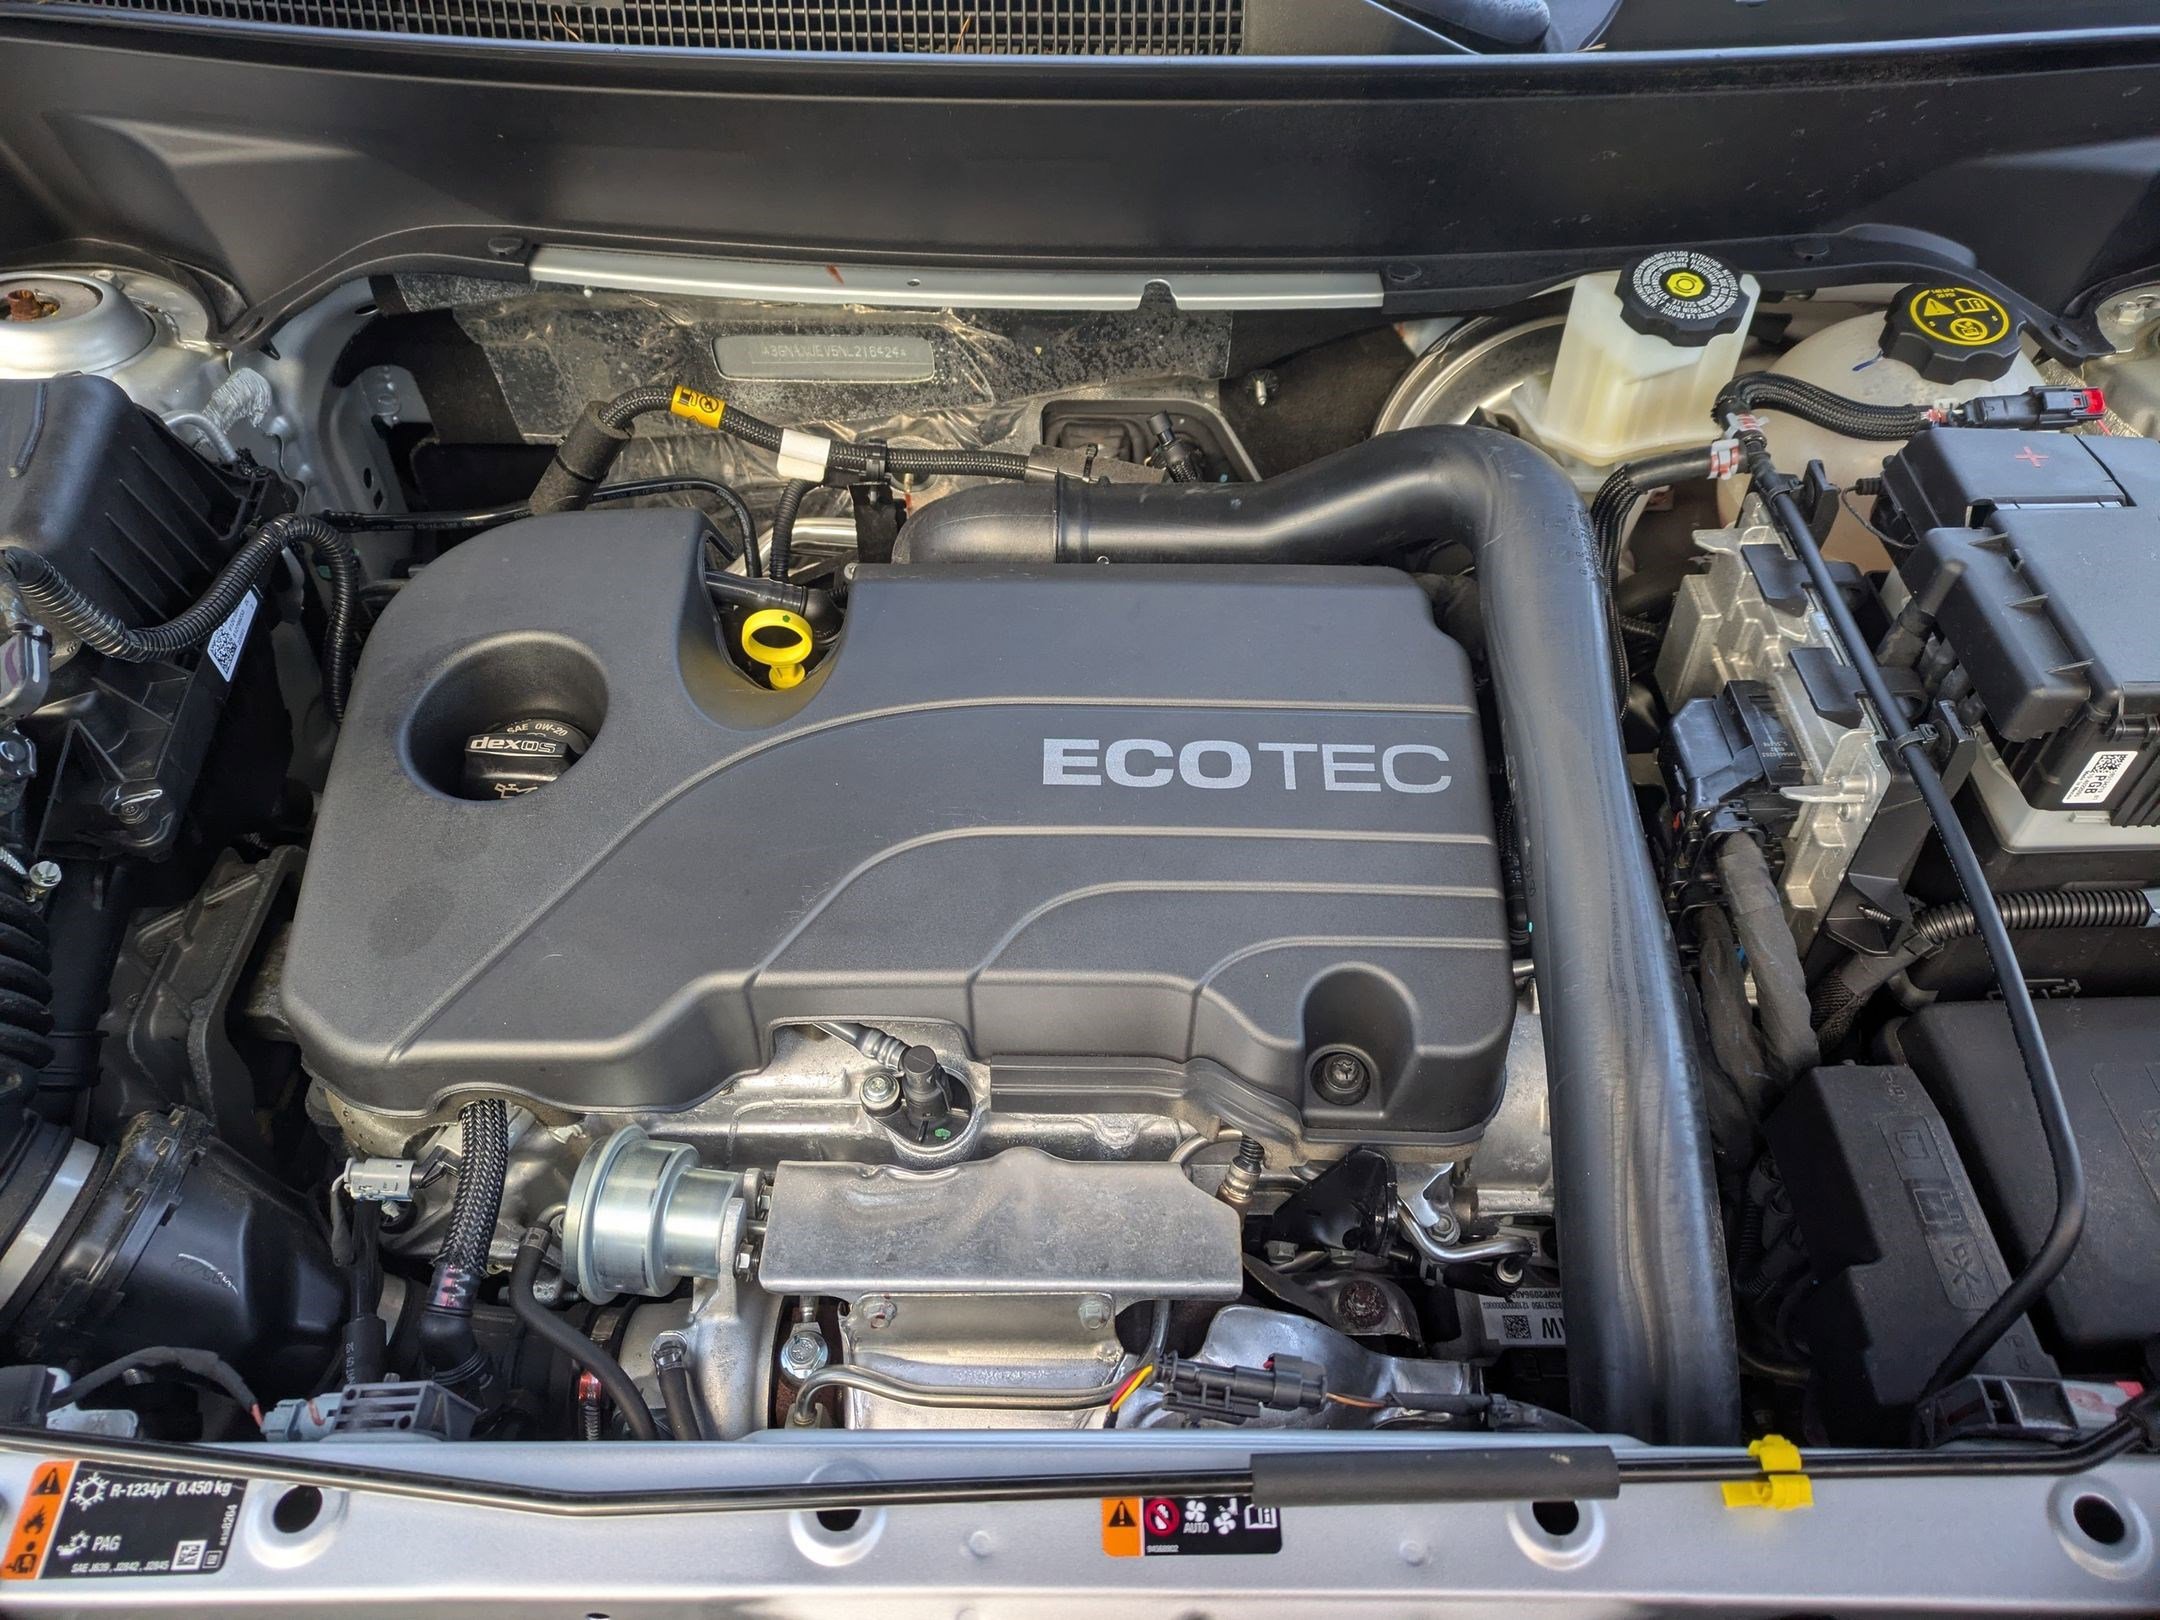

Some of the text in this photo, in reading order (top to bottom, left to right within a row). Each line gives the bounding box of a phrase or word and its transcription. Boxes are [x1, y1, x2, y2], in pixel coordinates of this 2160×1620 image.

[507, 722, 569, 737] SAE 0W-20
[470, 736, 557, 753] dexos
[1042, 738, 1453, 794] ECOTEC
[2085, 775, 2107, 794] PGB
[109, 1480, 232, 1499] R-1234yf 0.450 kg
[1183, 1521, 1210, 1534] AUTO
[92, 1535, 122, 1551] PAG
